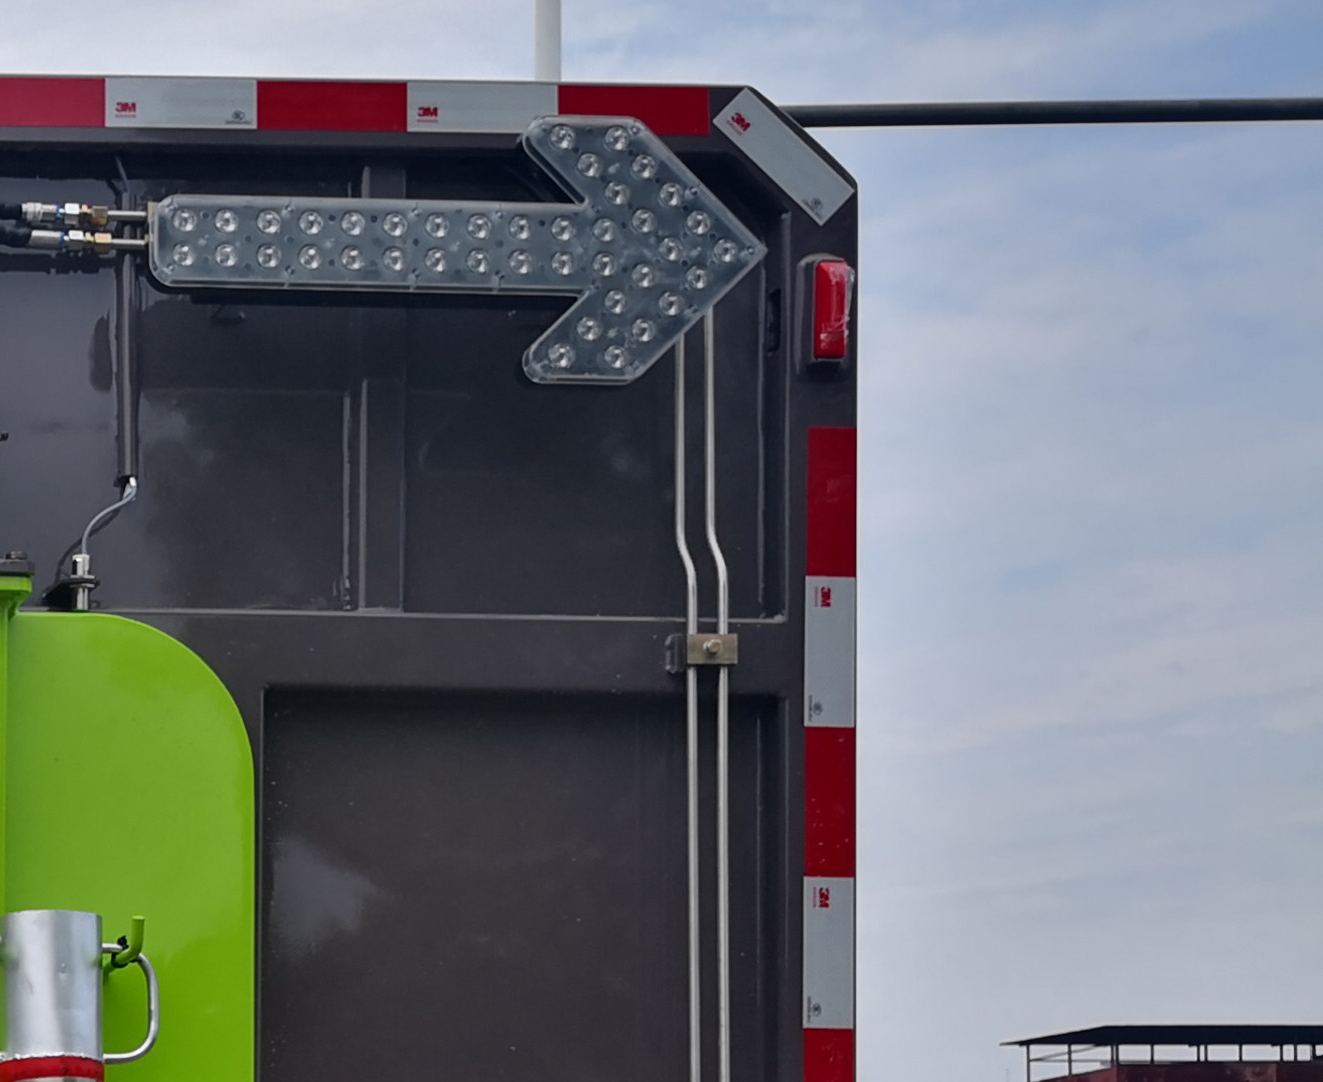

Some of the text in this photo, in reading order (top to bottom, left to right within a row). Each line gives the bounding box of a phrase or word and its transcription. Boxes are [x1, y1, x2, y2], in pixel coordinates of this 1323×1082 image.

[115, 101, 137, 113] 3M
[417, 106, 438, 117] 3M
[731, 112, 751, 131] 3M
[820, 586, 832, 608] 3M
[818, 887, 830, 909] 3M
